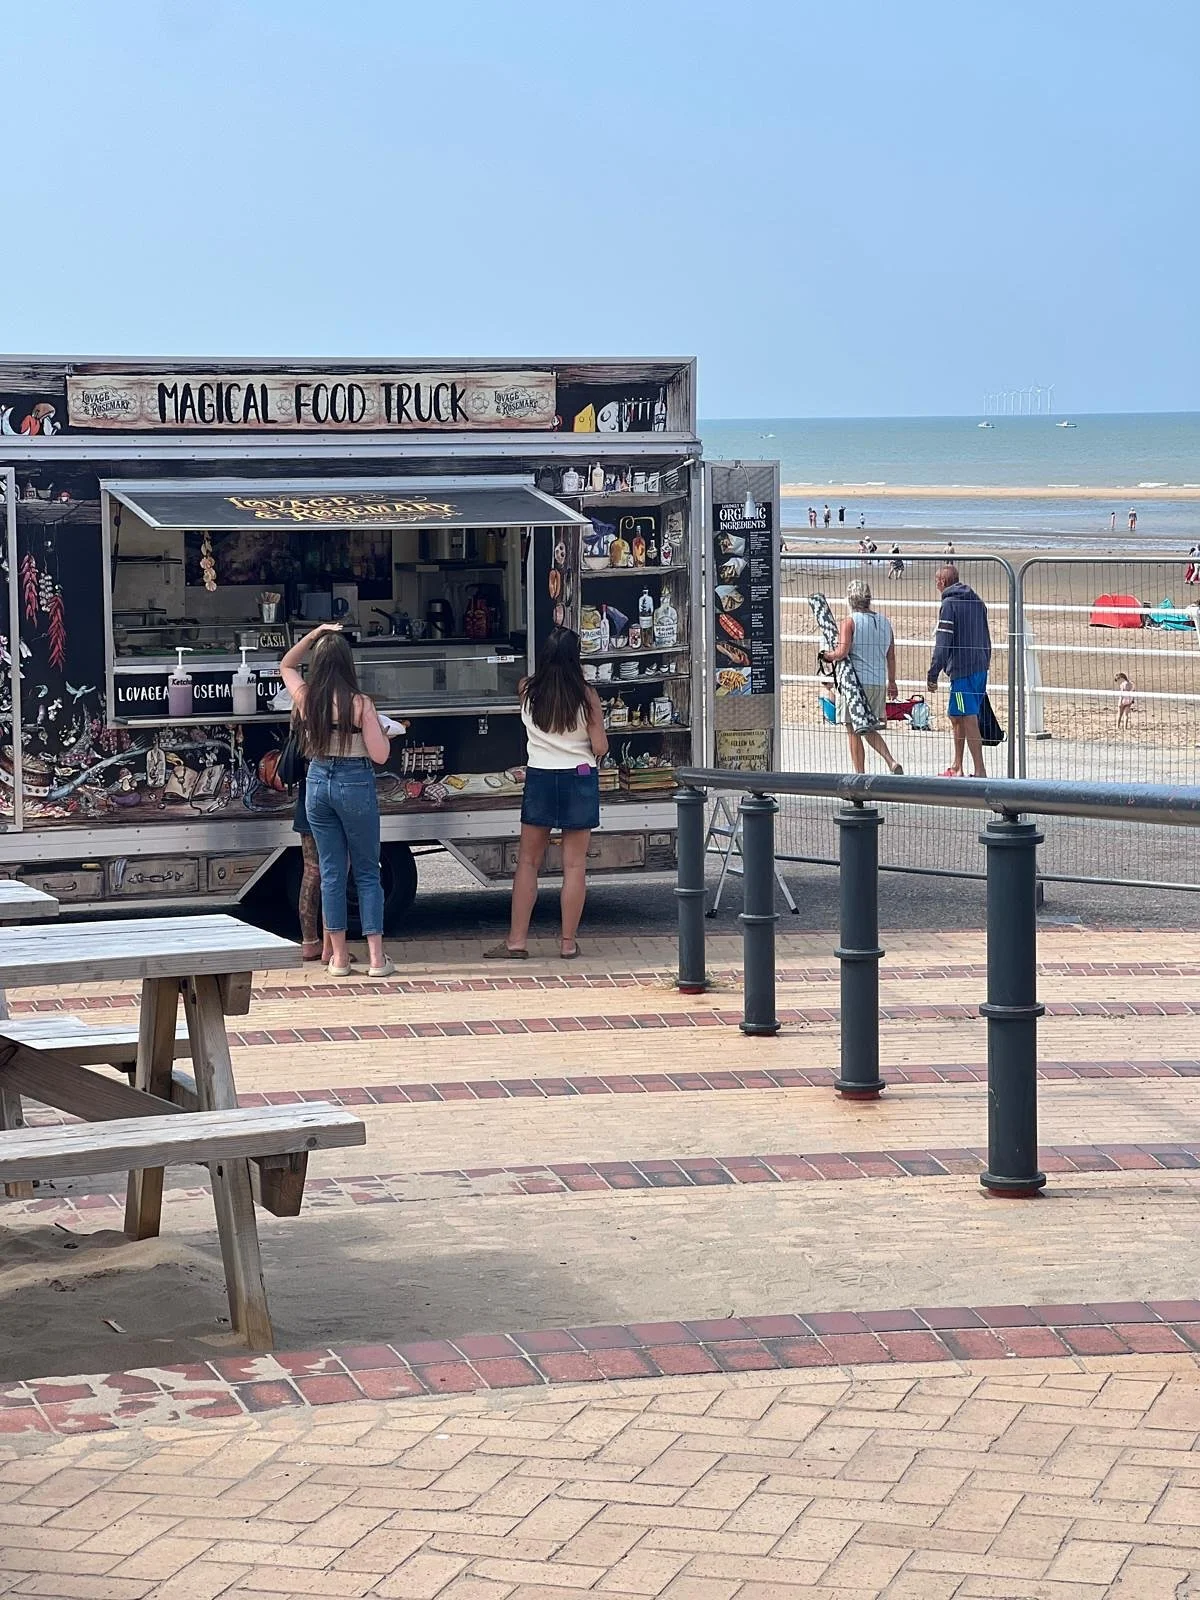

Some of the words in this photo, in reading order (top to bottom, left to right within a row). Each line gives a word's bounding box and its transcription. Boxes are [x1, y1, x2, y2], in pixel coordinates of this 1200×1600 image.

[82, 390, 110, 405] LOVAGE
[157, 381, 278, 424] MAGICAL
[294, 382, 367, 424] FOOD
[380, 381, 470, 424] TRUCK
[494, 390, 520, 403] LOVAGE
[91, 399, 131, 417] ROSEMARY
[502, 399, 540, 416] ROSEMARY
[224, 496, 352, 511] LOVAGE
[254, 509, 279, 519] &
[280, 502, 458, 522] ROSEMARY
[719, 507, 766, 522] ORGIC
[720, 520, 767, 531] INGREDIENTS
[260, 635, 285, 648] CASH
[171, 678, 193, 686] Ketch
